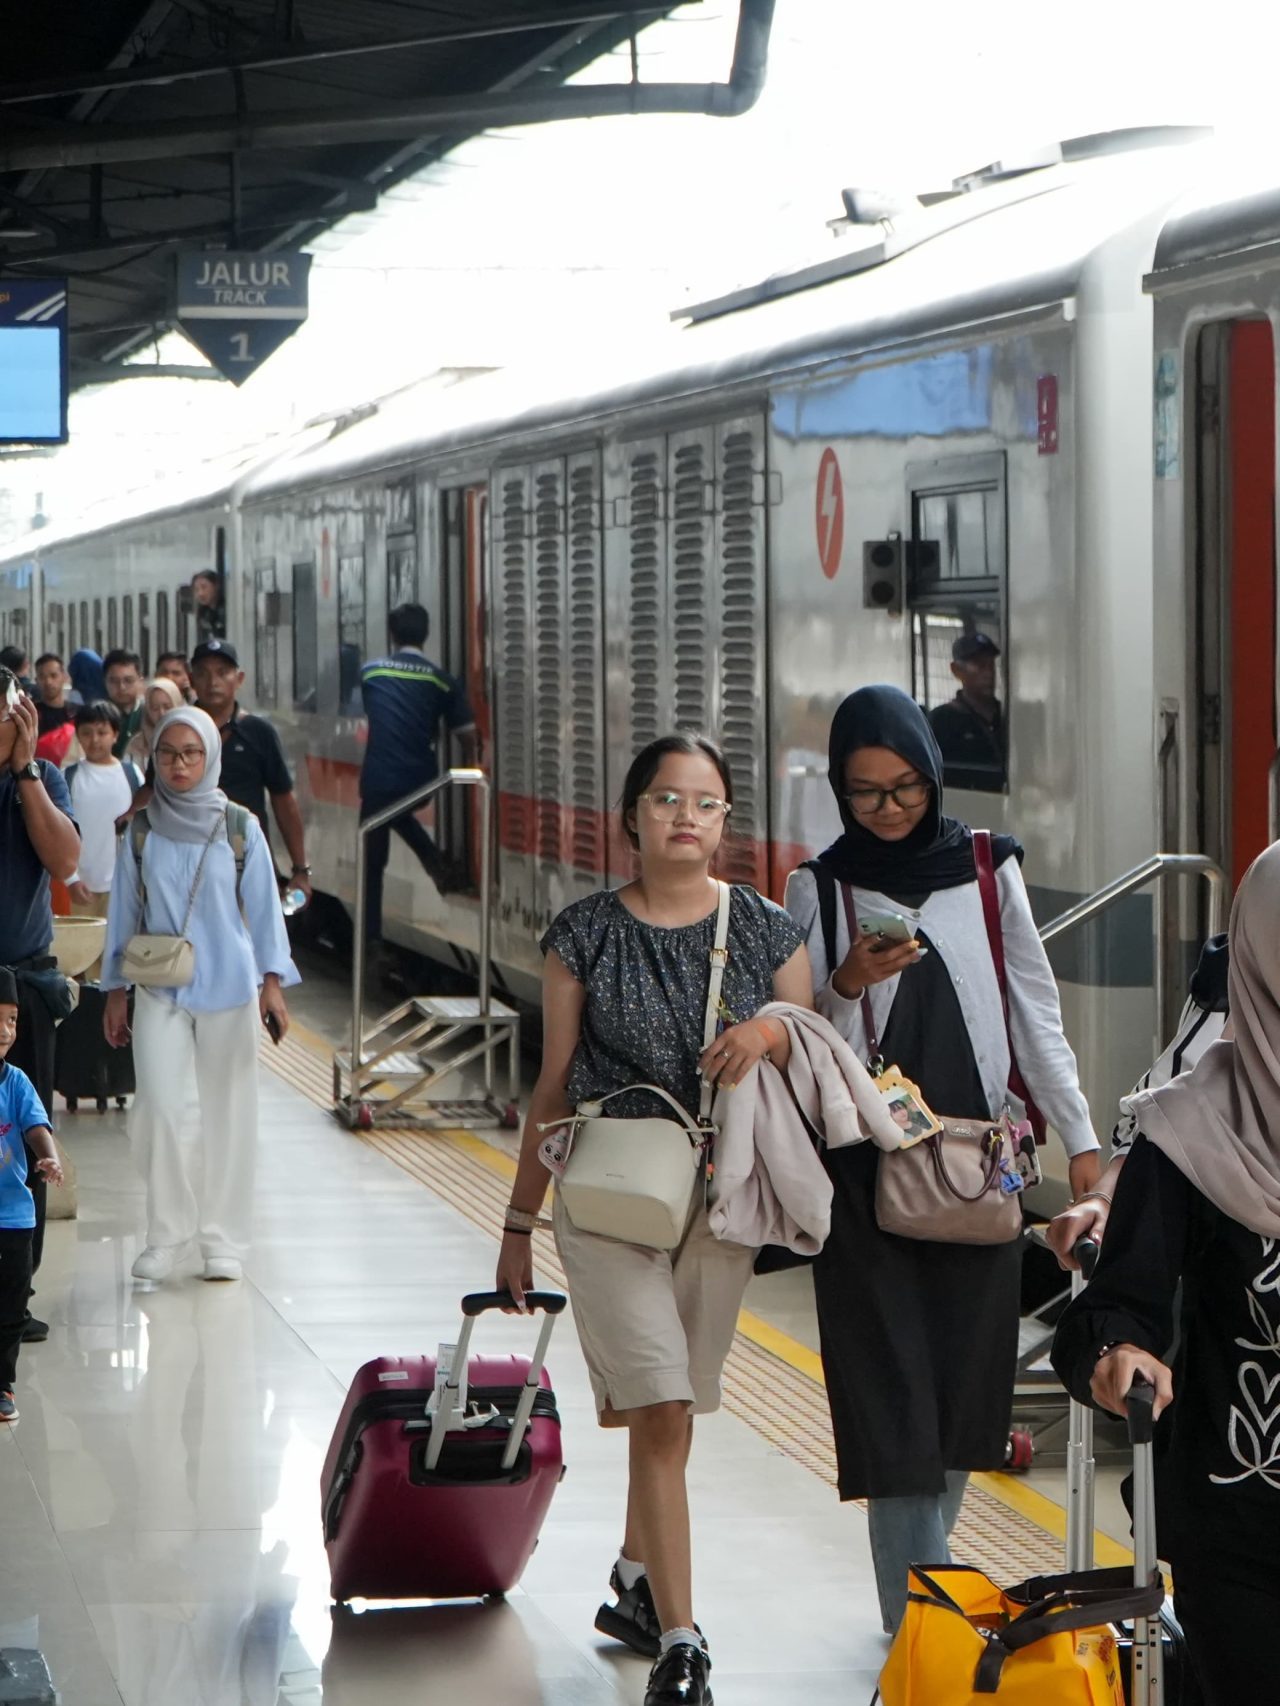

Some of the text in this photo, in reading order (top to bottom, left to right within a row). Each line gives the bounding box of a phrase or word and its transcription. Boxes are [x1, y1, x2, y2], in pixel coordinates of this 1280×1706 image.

[196, 261, 291, 286] JALUR
[213, 289, 267, 304] TRACK
[229, 332, 255, 362] 1
